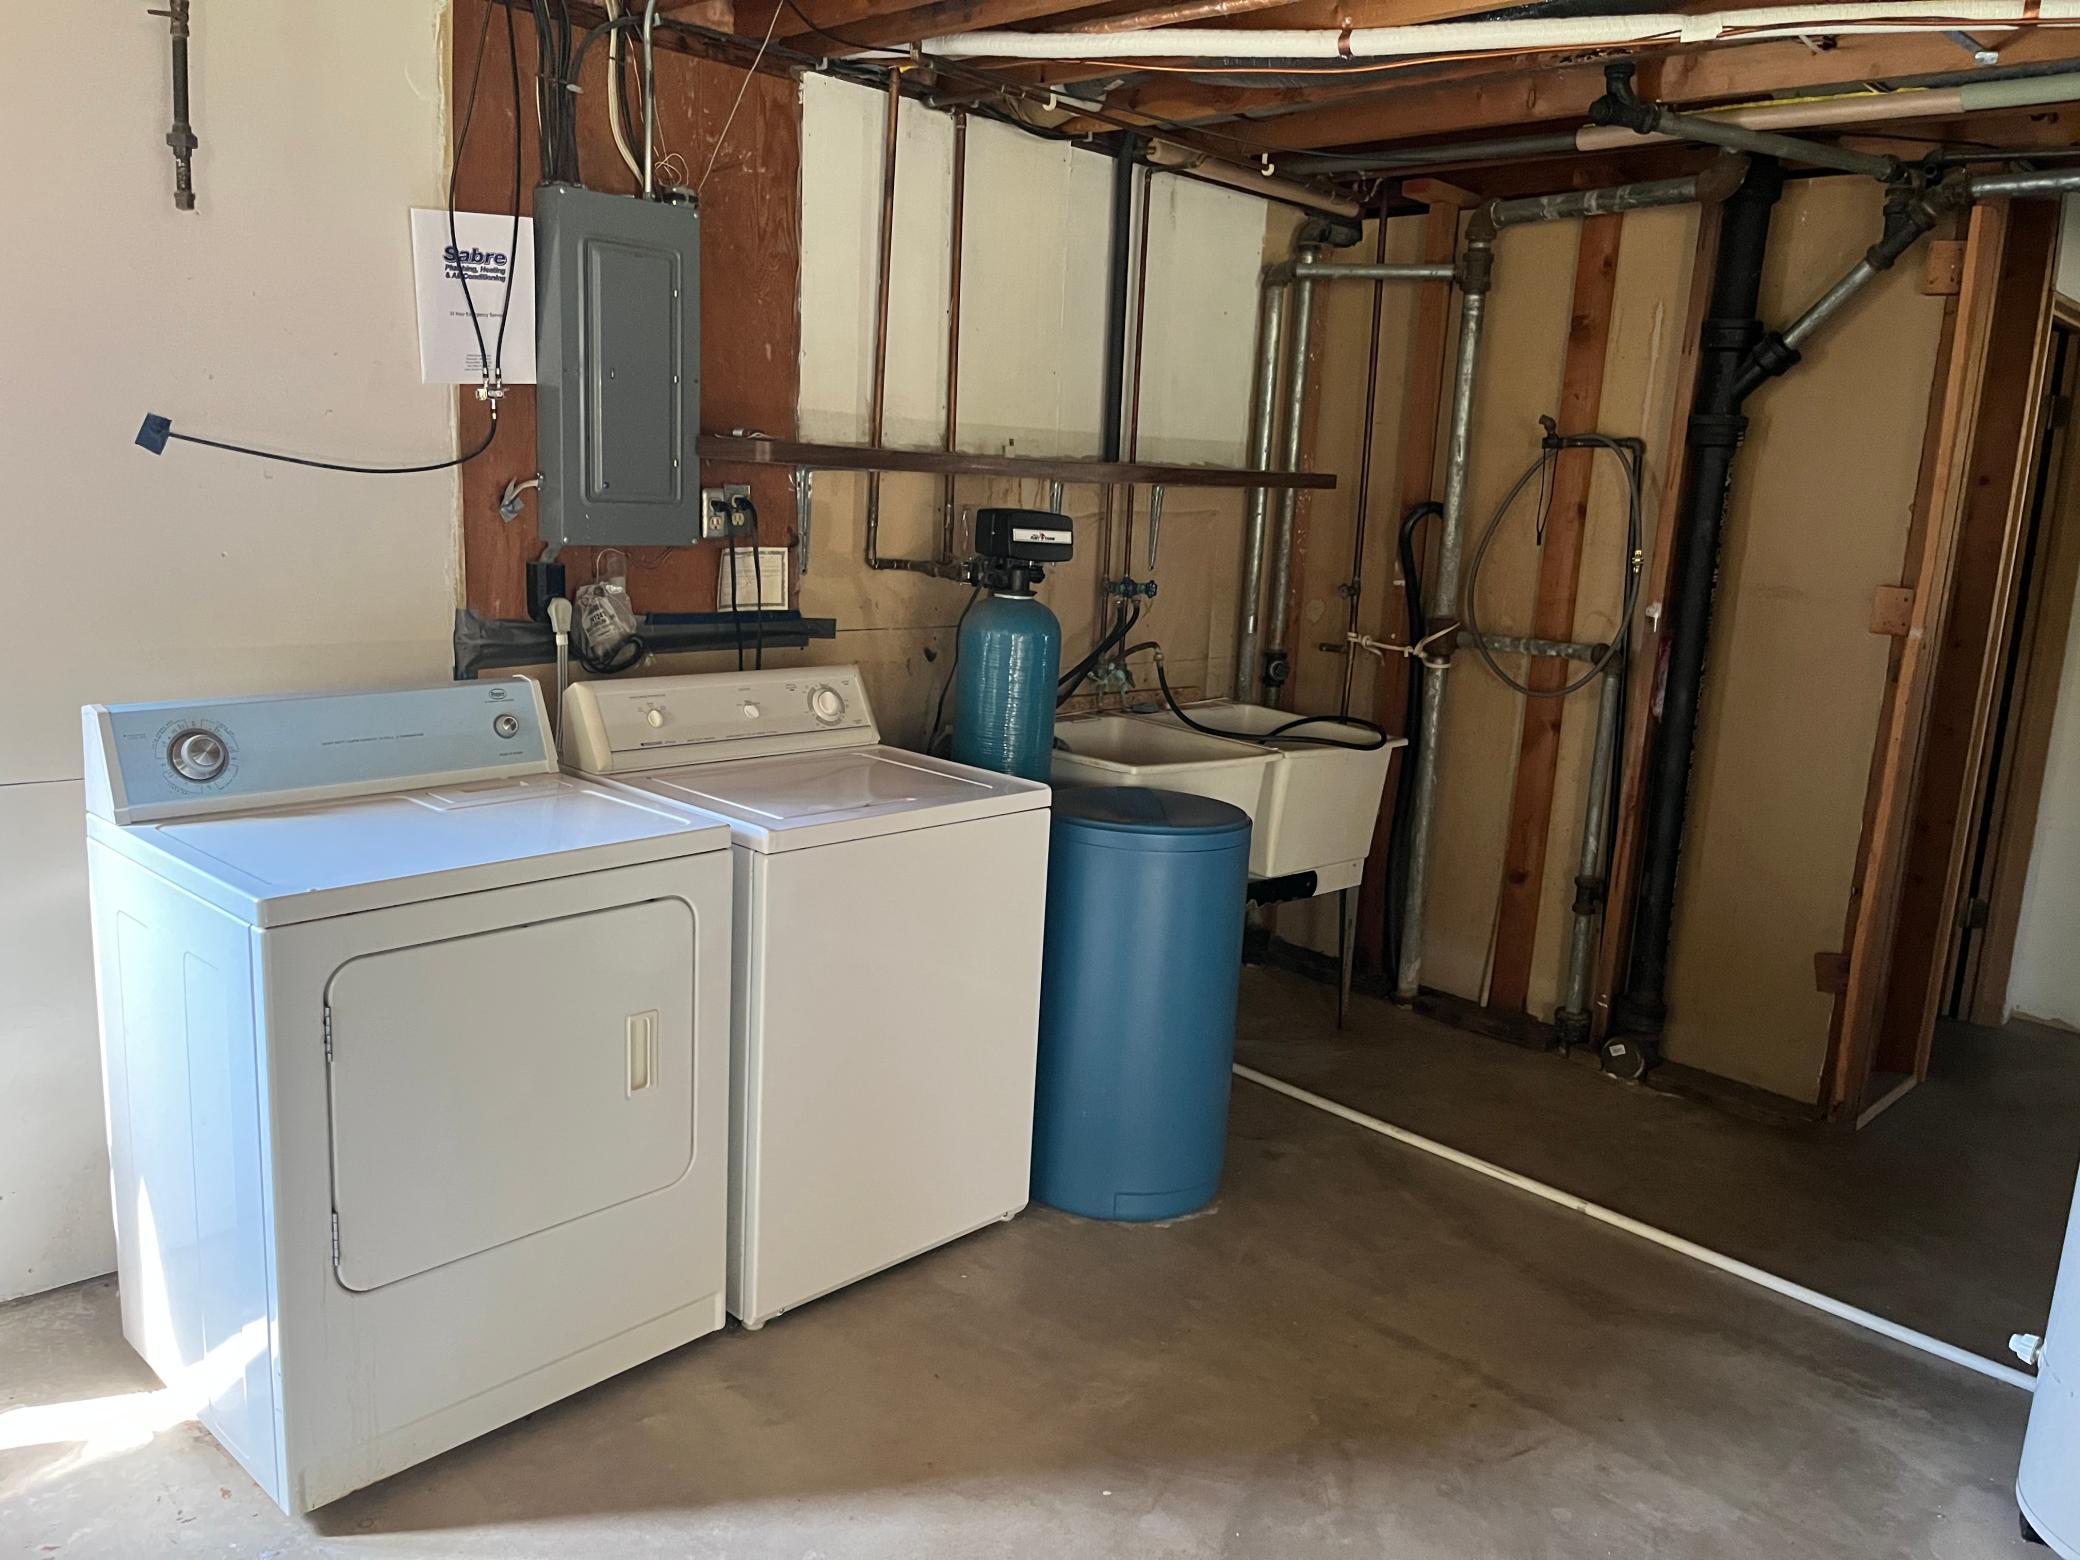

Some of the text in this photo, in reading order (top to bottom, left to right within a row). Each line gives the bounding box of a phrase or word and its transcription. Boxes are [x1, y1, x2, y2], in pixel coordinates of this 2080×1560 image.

[443, 246, 507, 266] Sabre
[480, 266, 506, 276] Heating
[463, 273, 506, 283] Conditioning
